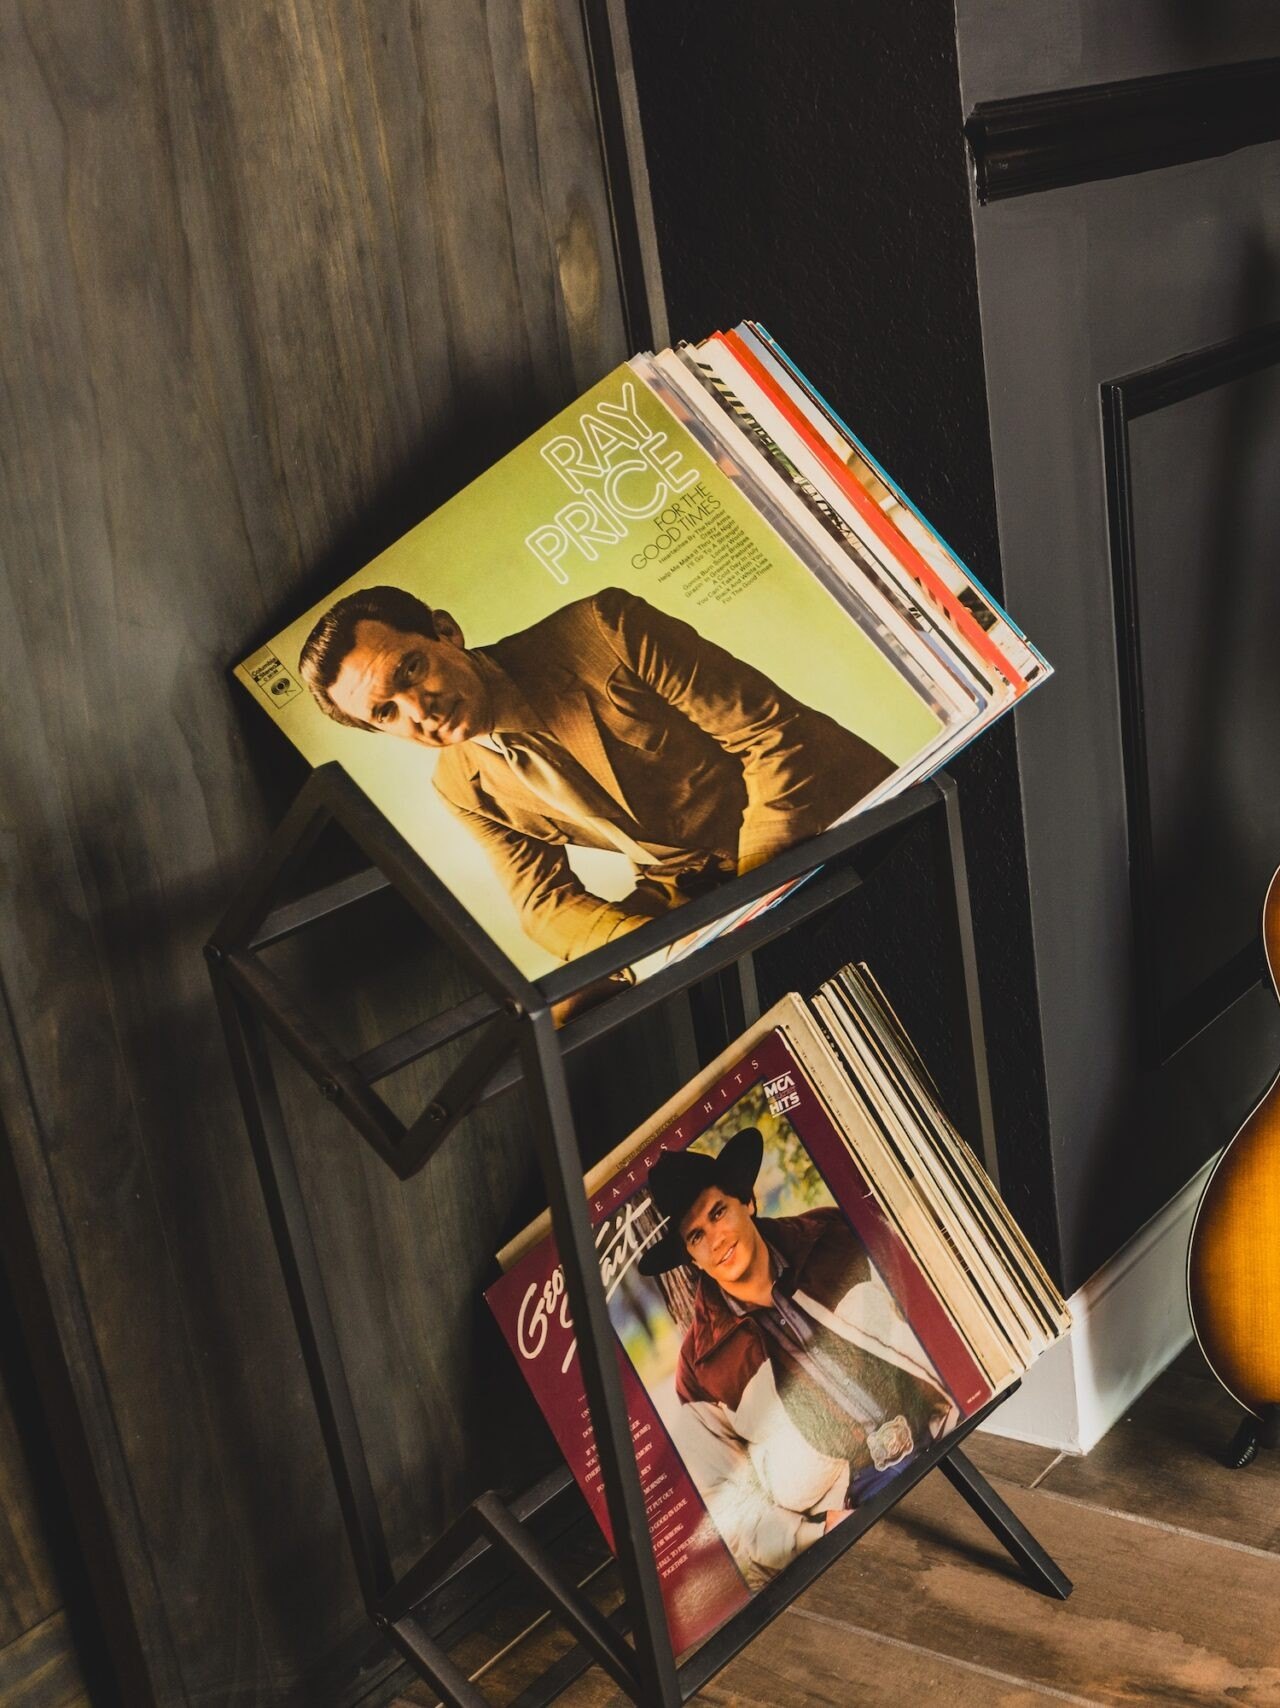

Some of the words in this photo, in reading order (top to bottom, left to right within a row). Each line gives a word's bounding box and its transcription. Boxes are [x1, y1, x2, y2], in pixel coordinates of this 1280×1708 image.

[540, 382, 653, 495] RAY
[525, 431, 700, 585] PRICE
[631, 526, 682, 570] GOOD
[677, 494, 722, 532] TIMES
[653, 502, 686, 532] FOR
[680, 482, 711, 509] THE
[763, 1075, 796, 1099] MCA
[769, 1091, 800, 1115] HITS
[594, 1127, 683, 1212] EATEST
[703, 1059, 759, 1113] HITS
